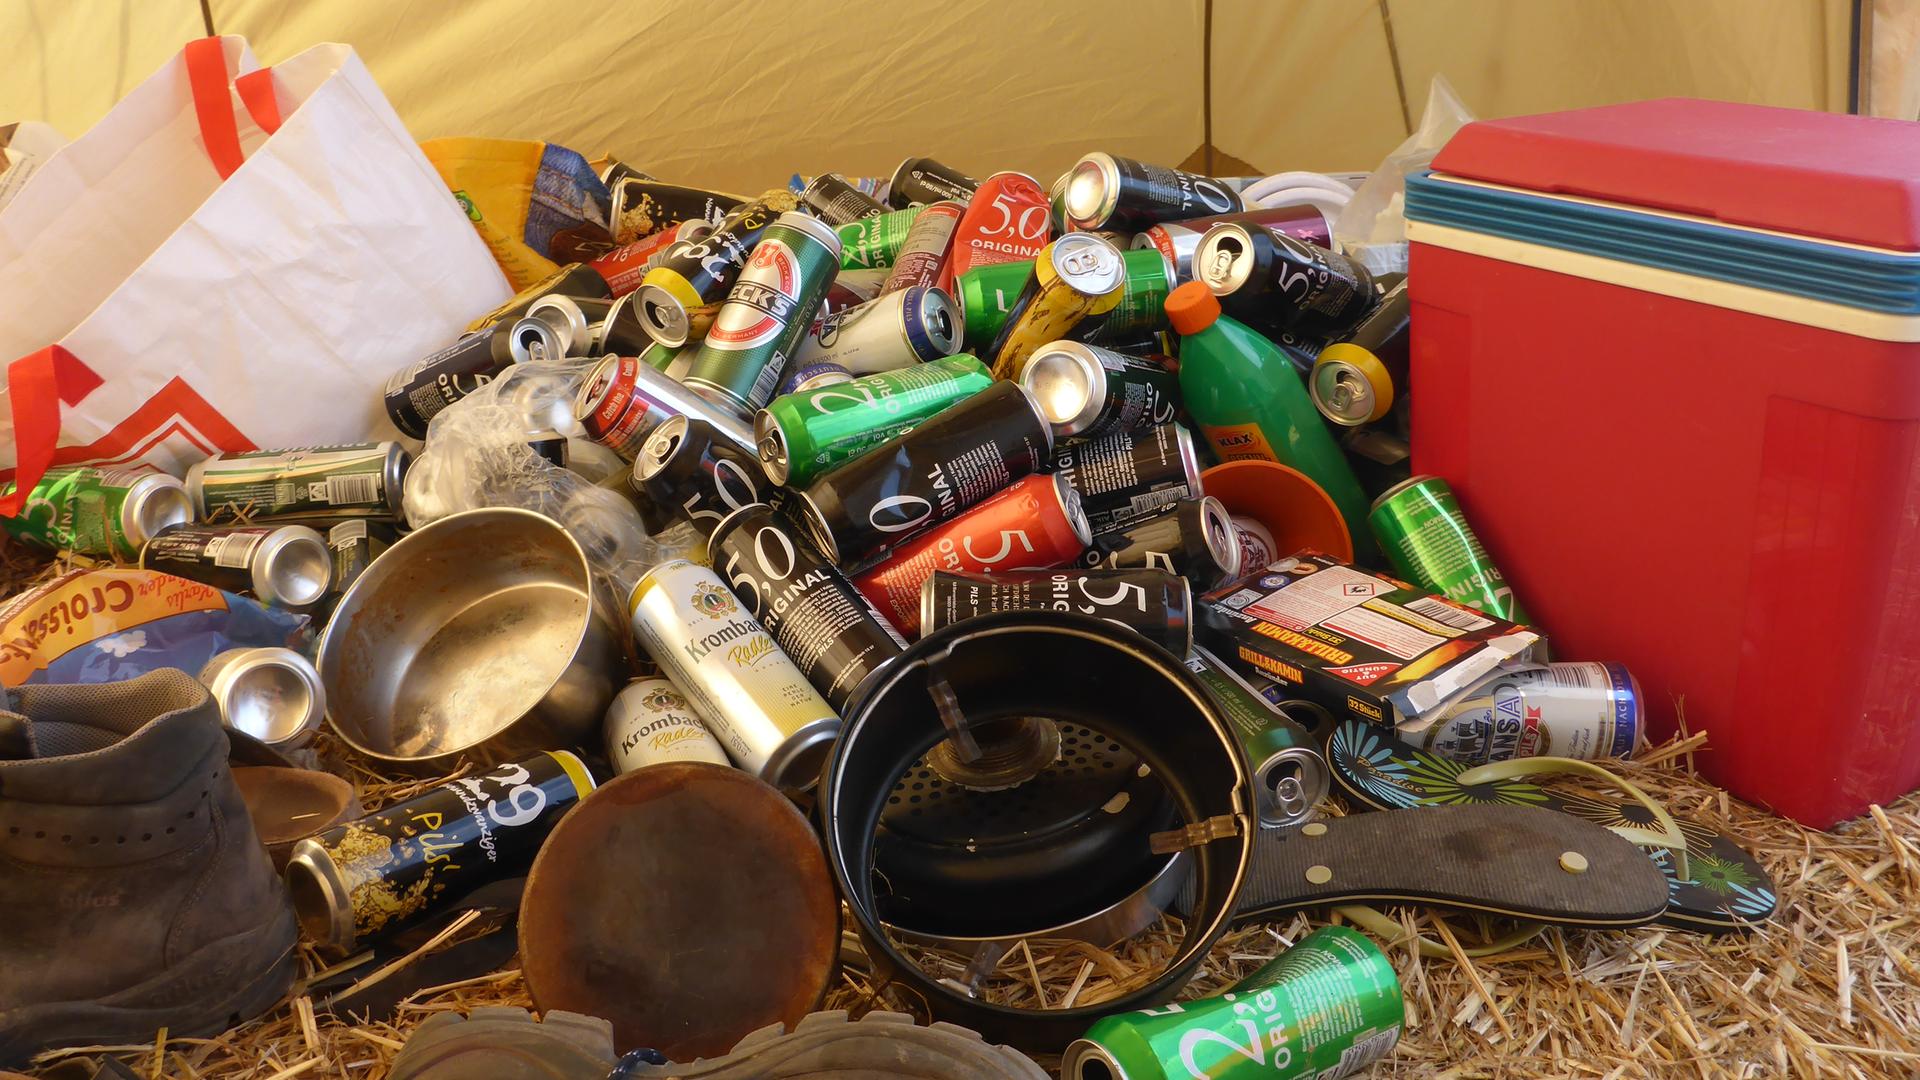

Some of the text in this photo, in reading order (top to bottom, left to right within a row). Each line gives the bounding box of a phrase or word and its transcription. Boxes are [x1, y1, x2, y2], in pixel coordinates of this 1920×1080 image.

[979, 193, 1049, 240] 5,0
[872, 214, 882, 269] ORIGINA
[970, 237, 1041, 257] ORIGINA
[727, 283, 791, 318] ECK'S
[869, 375, 901, 414] ORIG
[725, 526, 796, 621] 5,0
[1051, 575, 1070, 612] ORIG
[1449, 567, 1503, 601] RIGIN
[764, 568, 831, 633] RIGINAL
[684, 618, 764, 664] Krombac
[817, 637, 834, 656] PILS
[1253, 621, 1352, 665] GRILL&KAMIN
[1239, 646, 1303, 684] GRILL&KAMIN
[621, 713, 705, 757] Krombac
[1490, 696, 1521, 761] ANSA
[466, 763, 547, 827] 29
[1255, 987, 1292, 1070] ORIG
